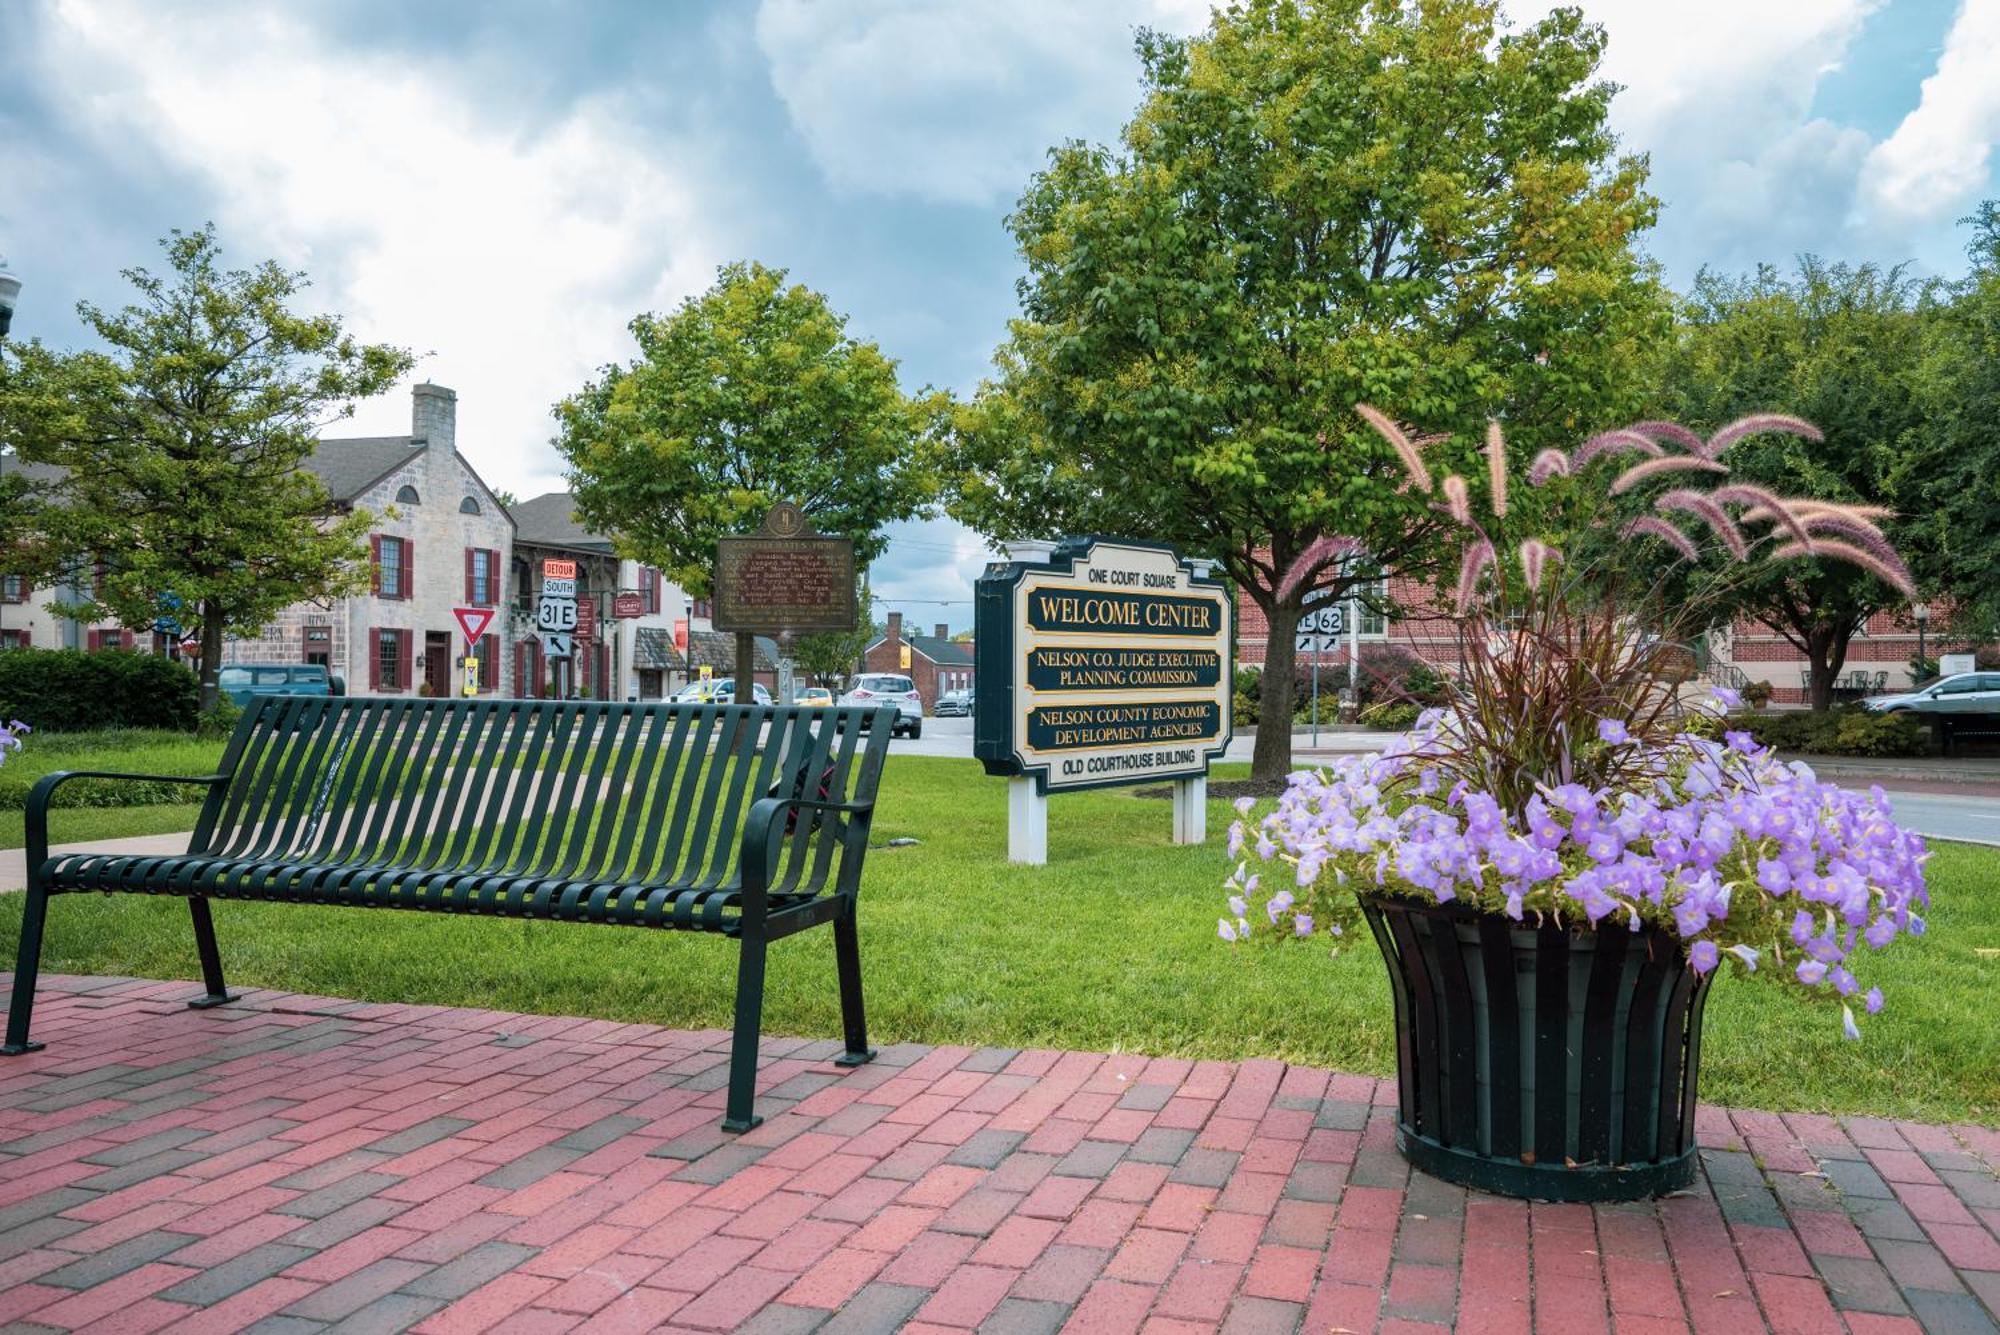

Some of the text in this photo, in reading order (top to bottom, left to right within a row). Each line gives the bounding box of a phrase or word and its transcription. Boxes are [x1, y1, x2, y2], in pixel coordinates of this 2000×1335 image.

[546, 563, 574, 575] DETOUR
[546, 580, 573, 593] SOUTH
[1088, 568, 1176, 589] ONE COURT SQUARE
[1039, 596, 1211, 629] WELCOME CENTER
[1321, 613, 1340, 629] 62
[1037, 652, 1217, 667] NELSON CO. JUDGE EXECUTIVE
[1060, 670, 1198, 685] PLANNING COMMISSION
[1039, 705, 1211, 727] NELSON COUNTY ECONOMIC
[1055, 722, 1203, 745] DEVELOPMENT AGENCIES
[1062, 749, 1196, 775] OLD COURTHOUSE BUILDING
